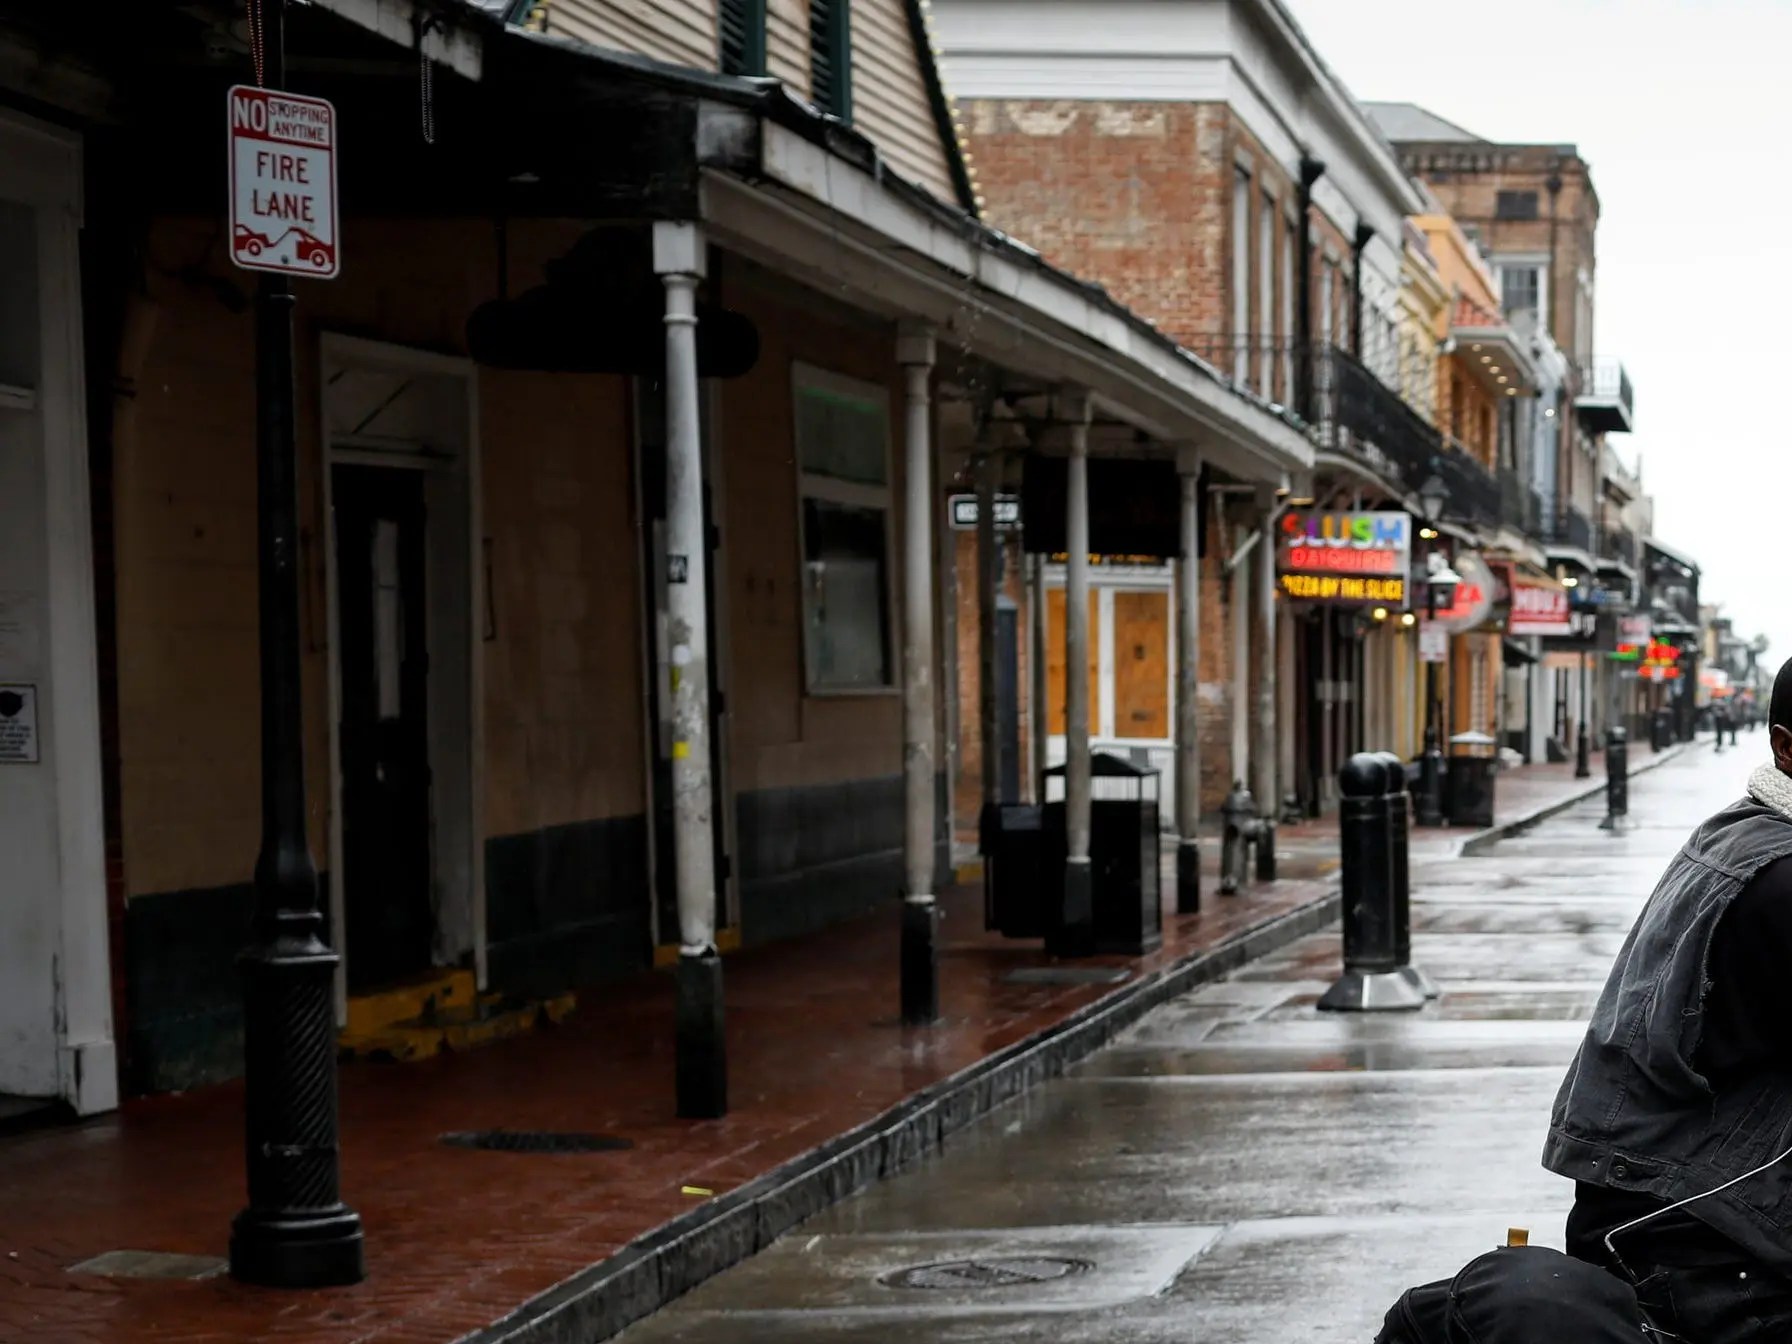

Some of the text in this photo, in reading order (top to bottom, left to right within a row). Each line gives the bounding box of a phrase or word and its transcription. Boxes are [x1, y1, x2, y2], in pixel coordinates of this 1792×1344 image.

[234, 96, 266, 132] NO
[269, 102, 329, 123] STOPPING
[273, 120, 325, 141] ANYTIME
[256, 151, 309, 184] FIRE
[252, 189, 314, 222] LANE
[1282, 513, 1403, 548] SLUSH
[1320, 577, 1340, 597] BY
[1341, 578, 1365, 599] THE
